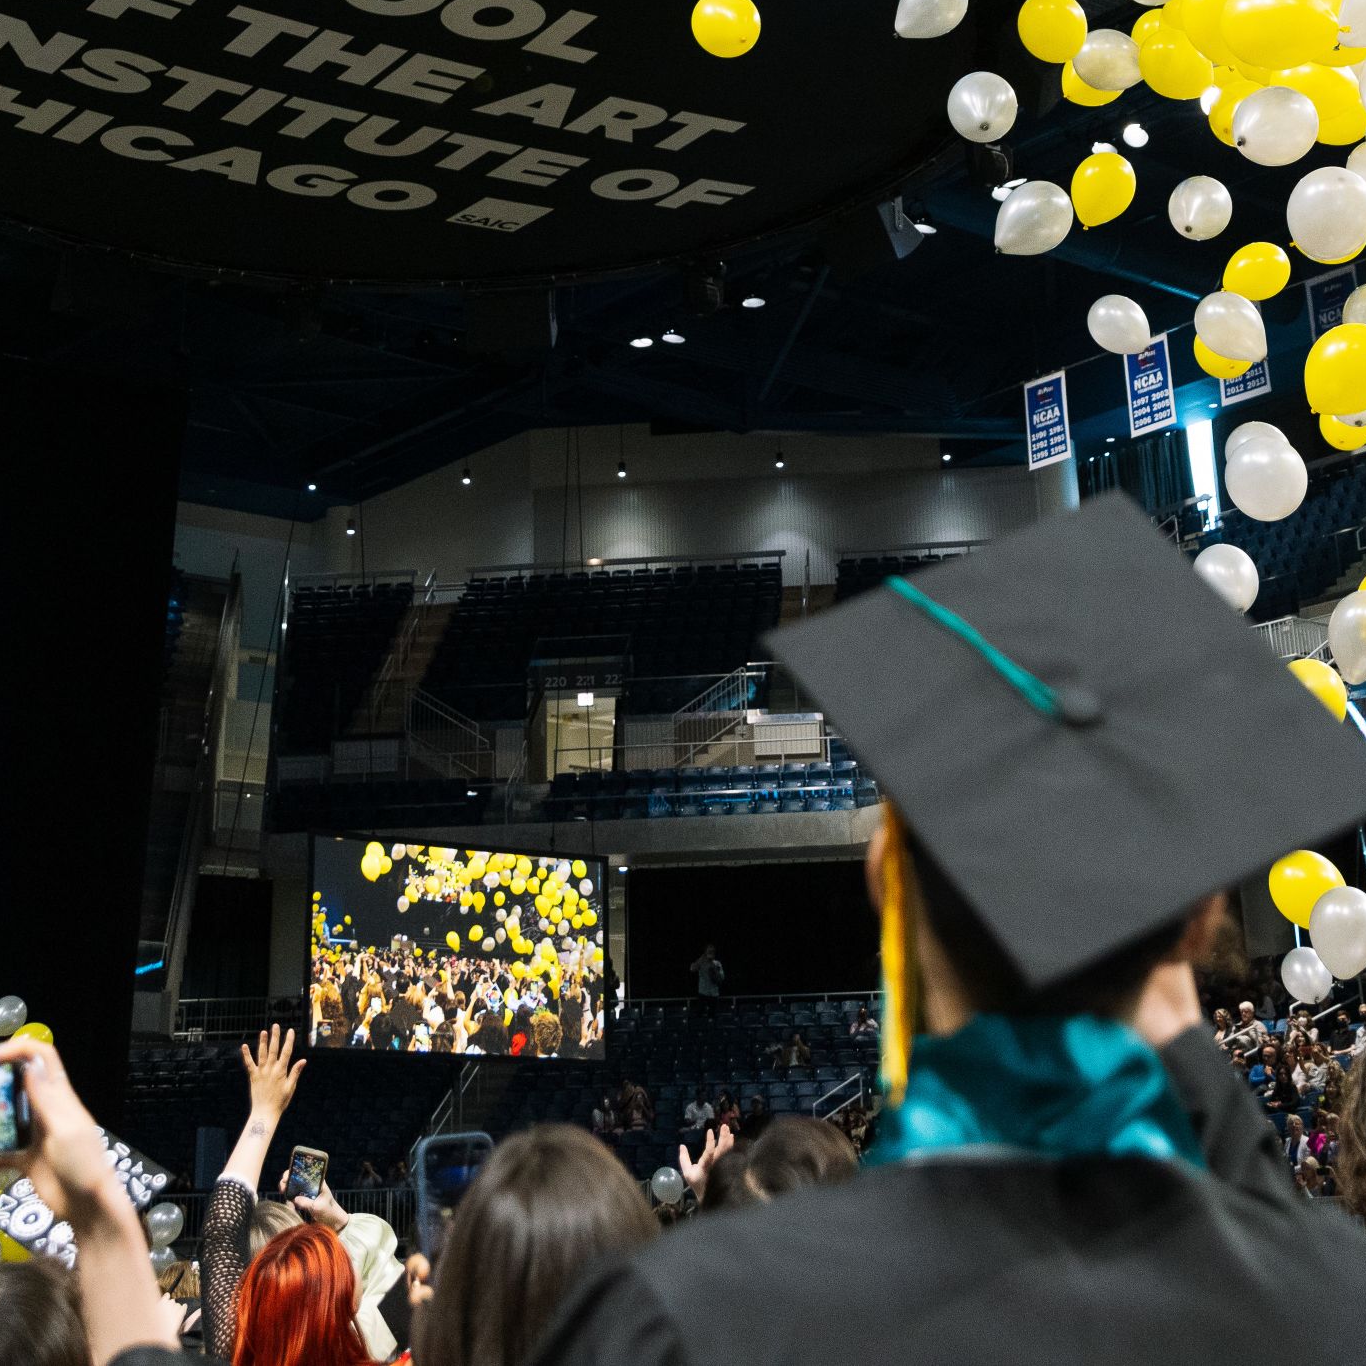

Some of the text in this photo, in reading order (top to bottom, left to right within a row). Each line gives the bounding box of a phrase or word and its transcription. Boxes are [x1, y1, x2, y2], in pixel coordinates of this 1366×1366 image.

[225, 5, 485, 103] THE
[473, 84, 746, 150] ART
[590, 170, 755, 208] OF
[457, 214, 520, 230] SAIC
[1318, 308, 1342, 325] NCA
[1133, 371, 1164, 391] NCAA
[1226, 384, 1244, 395] 2012
[1033, 407, 1061, 425] NCAA
[545, 676, 567, 688] 220
